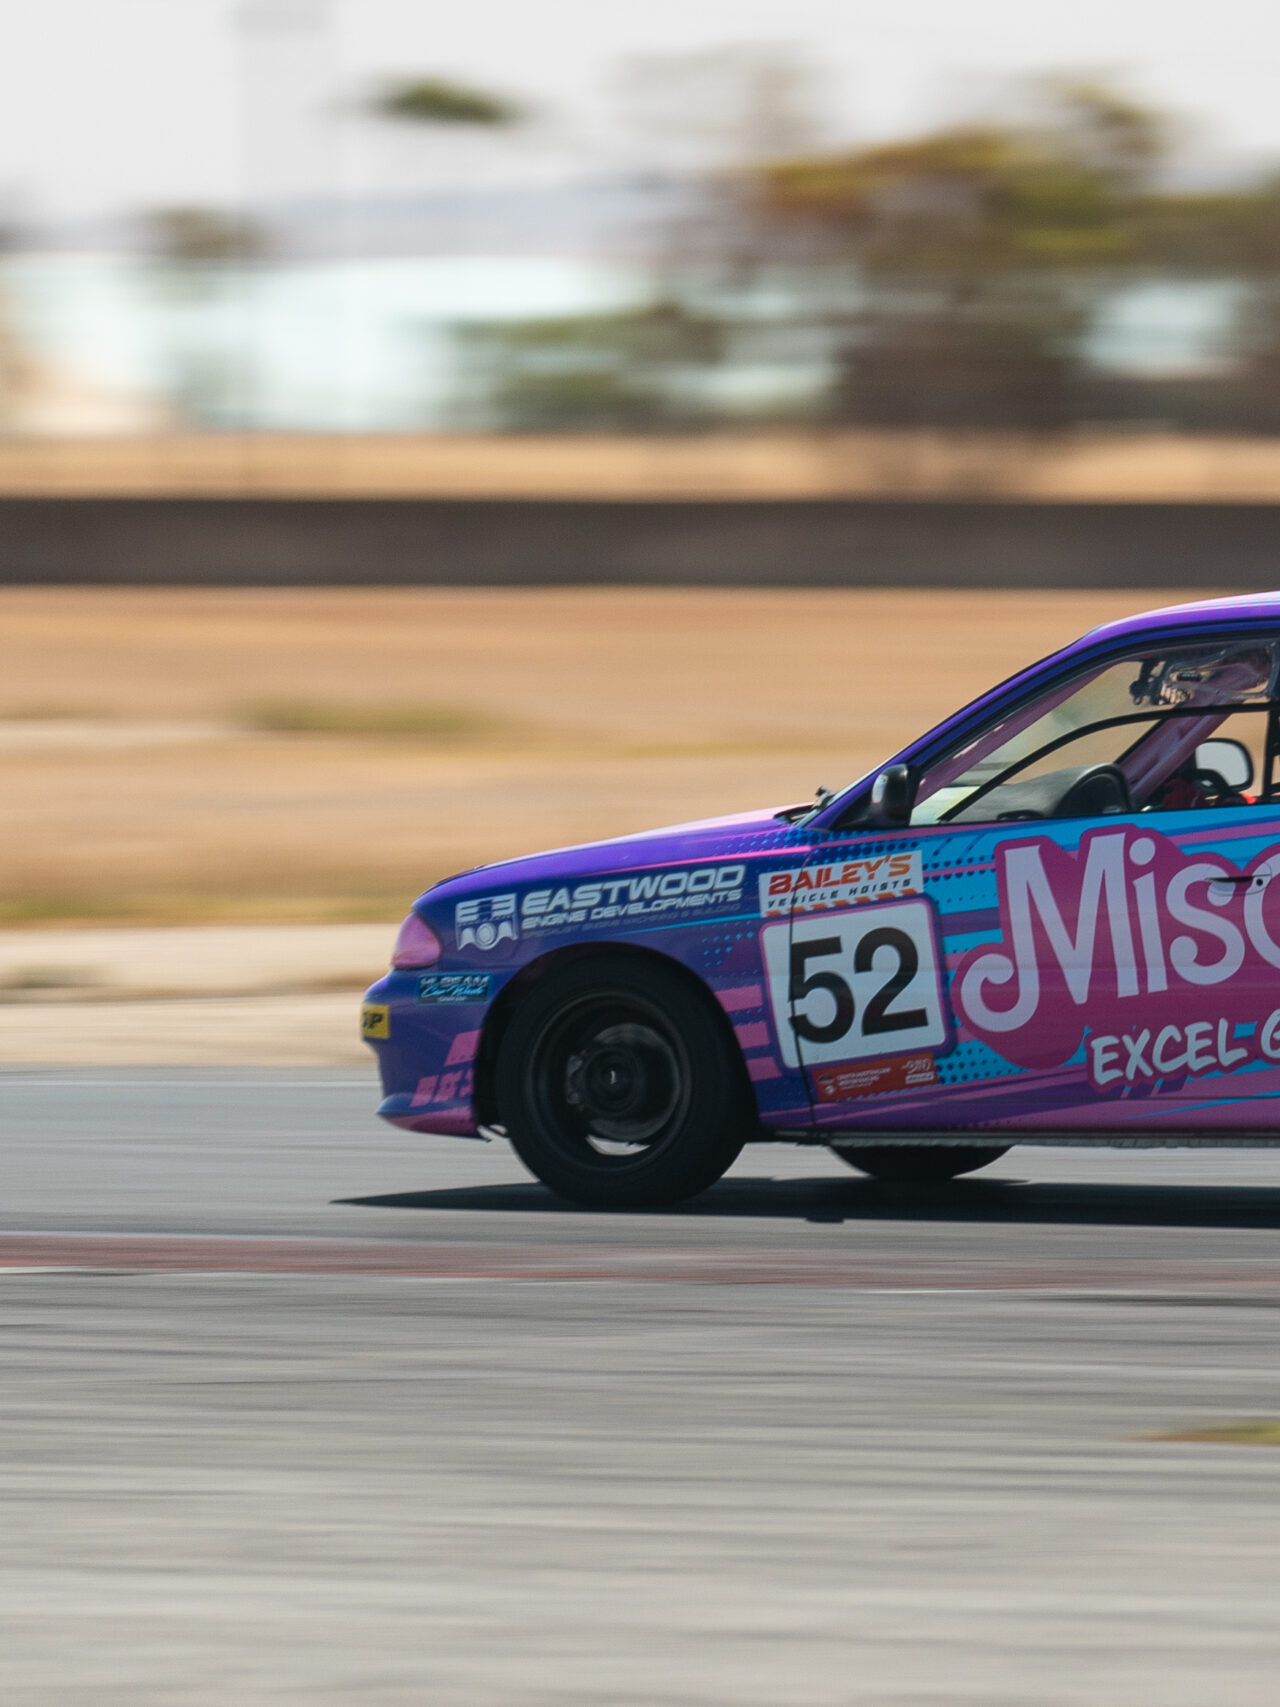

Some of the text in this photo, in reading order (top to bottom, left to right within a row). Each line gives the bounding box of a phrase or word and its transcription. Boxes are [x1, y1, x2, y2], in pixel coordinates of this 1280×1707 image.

[521, 865, 746, 915] EASTWOOD
[767, 878, 912, 908] VEHICLE HOISTS
[768, 854, 912, 895] BAILEY'S
[521, 888, 744, 930] ENGINE DEVELOPMENTS
[788, 927, 929, 1043] 52
[1090, 1017, 1250, 1086] EXCEL
